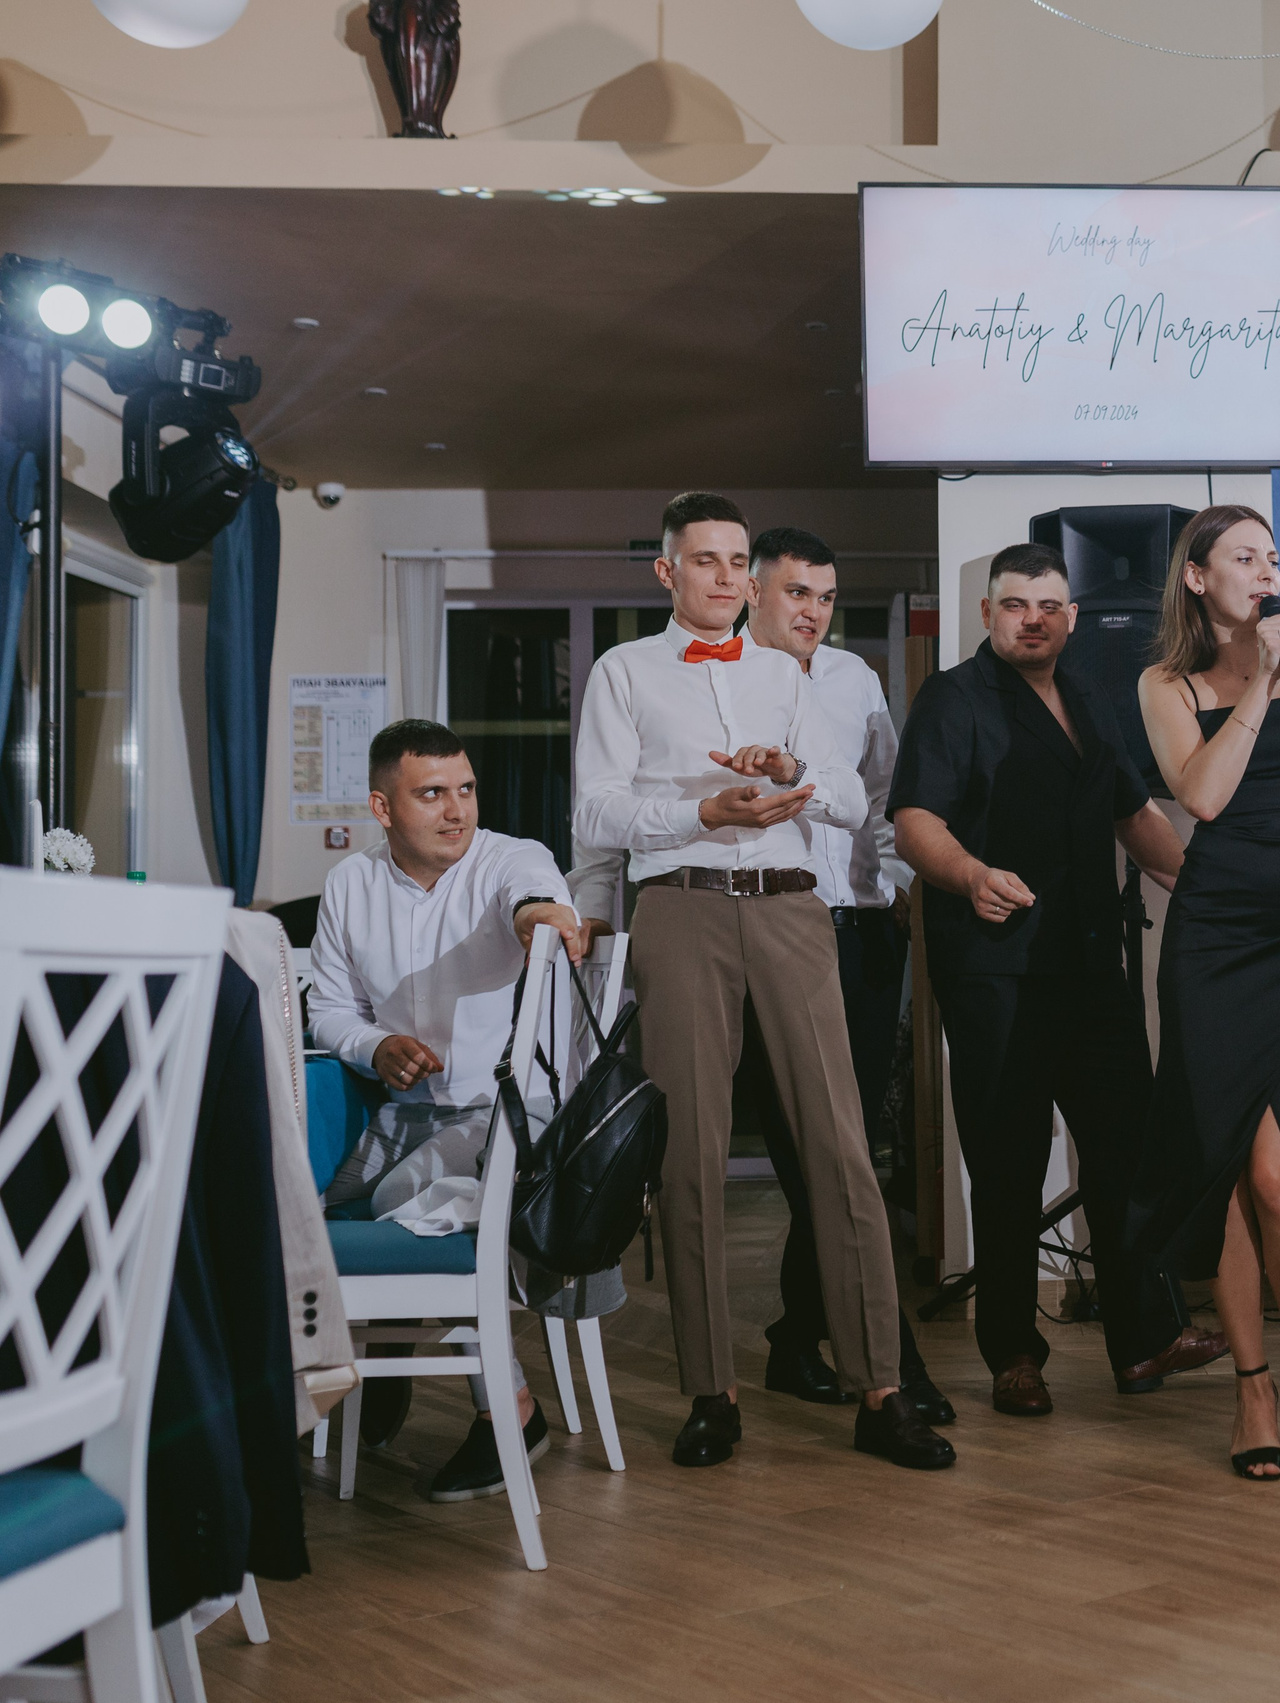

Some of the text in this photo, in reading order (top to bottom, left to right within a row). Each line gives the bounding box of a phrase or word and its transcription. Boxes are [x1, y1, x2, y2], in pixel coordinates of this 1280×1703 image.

[1047, 221, 1156, 267] Wedding day
[1067, 312, 1088, 345] &
[1074, 403, 1139, 421] 07.09.2024
[292, 677, 387, 689] ПЛАН ЭВАКУАЦИИ
